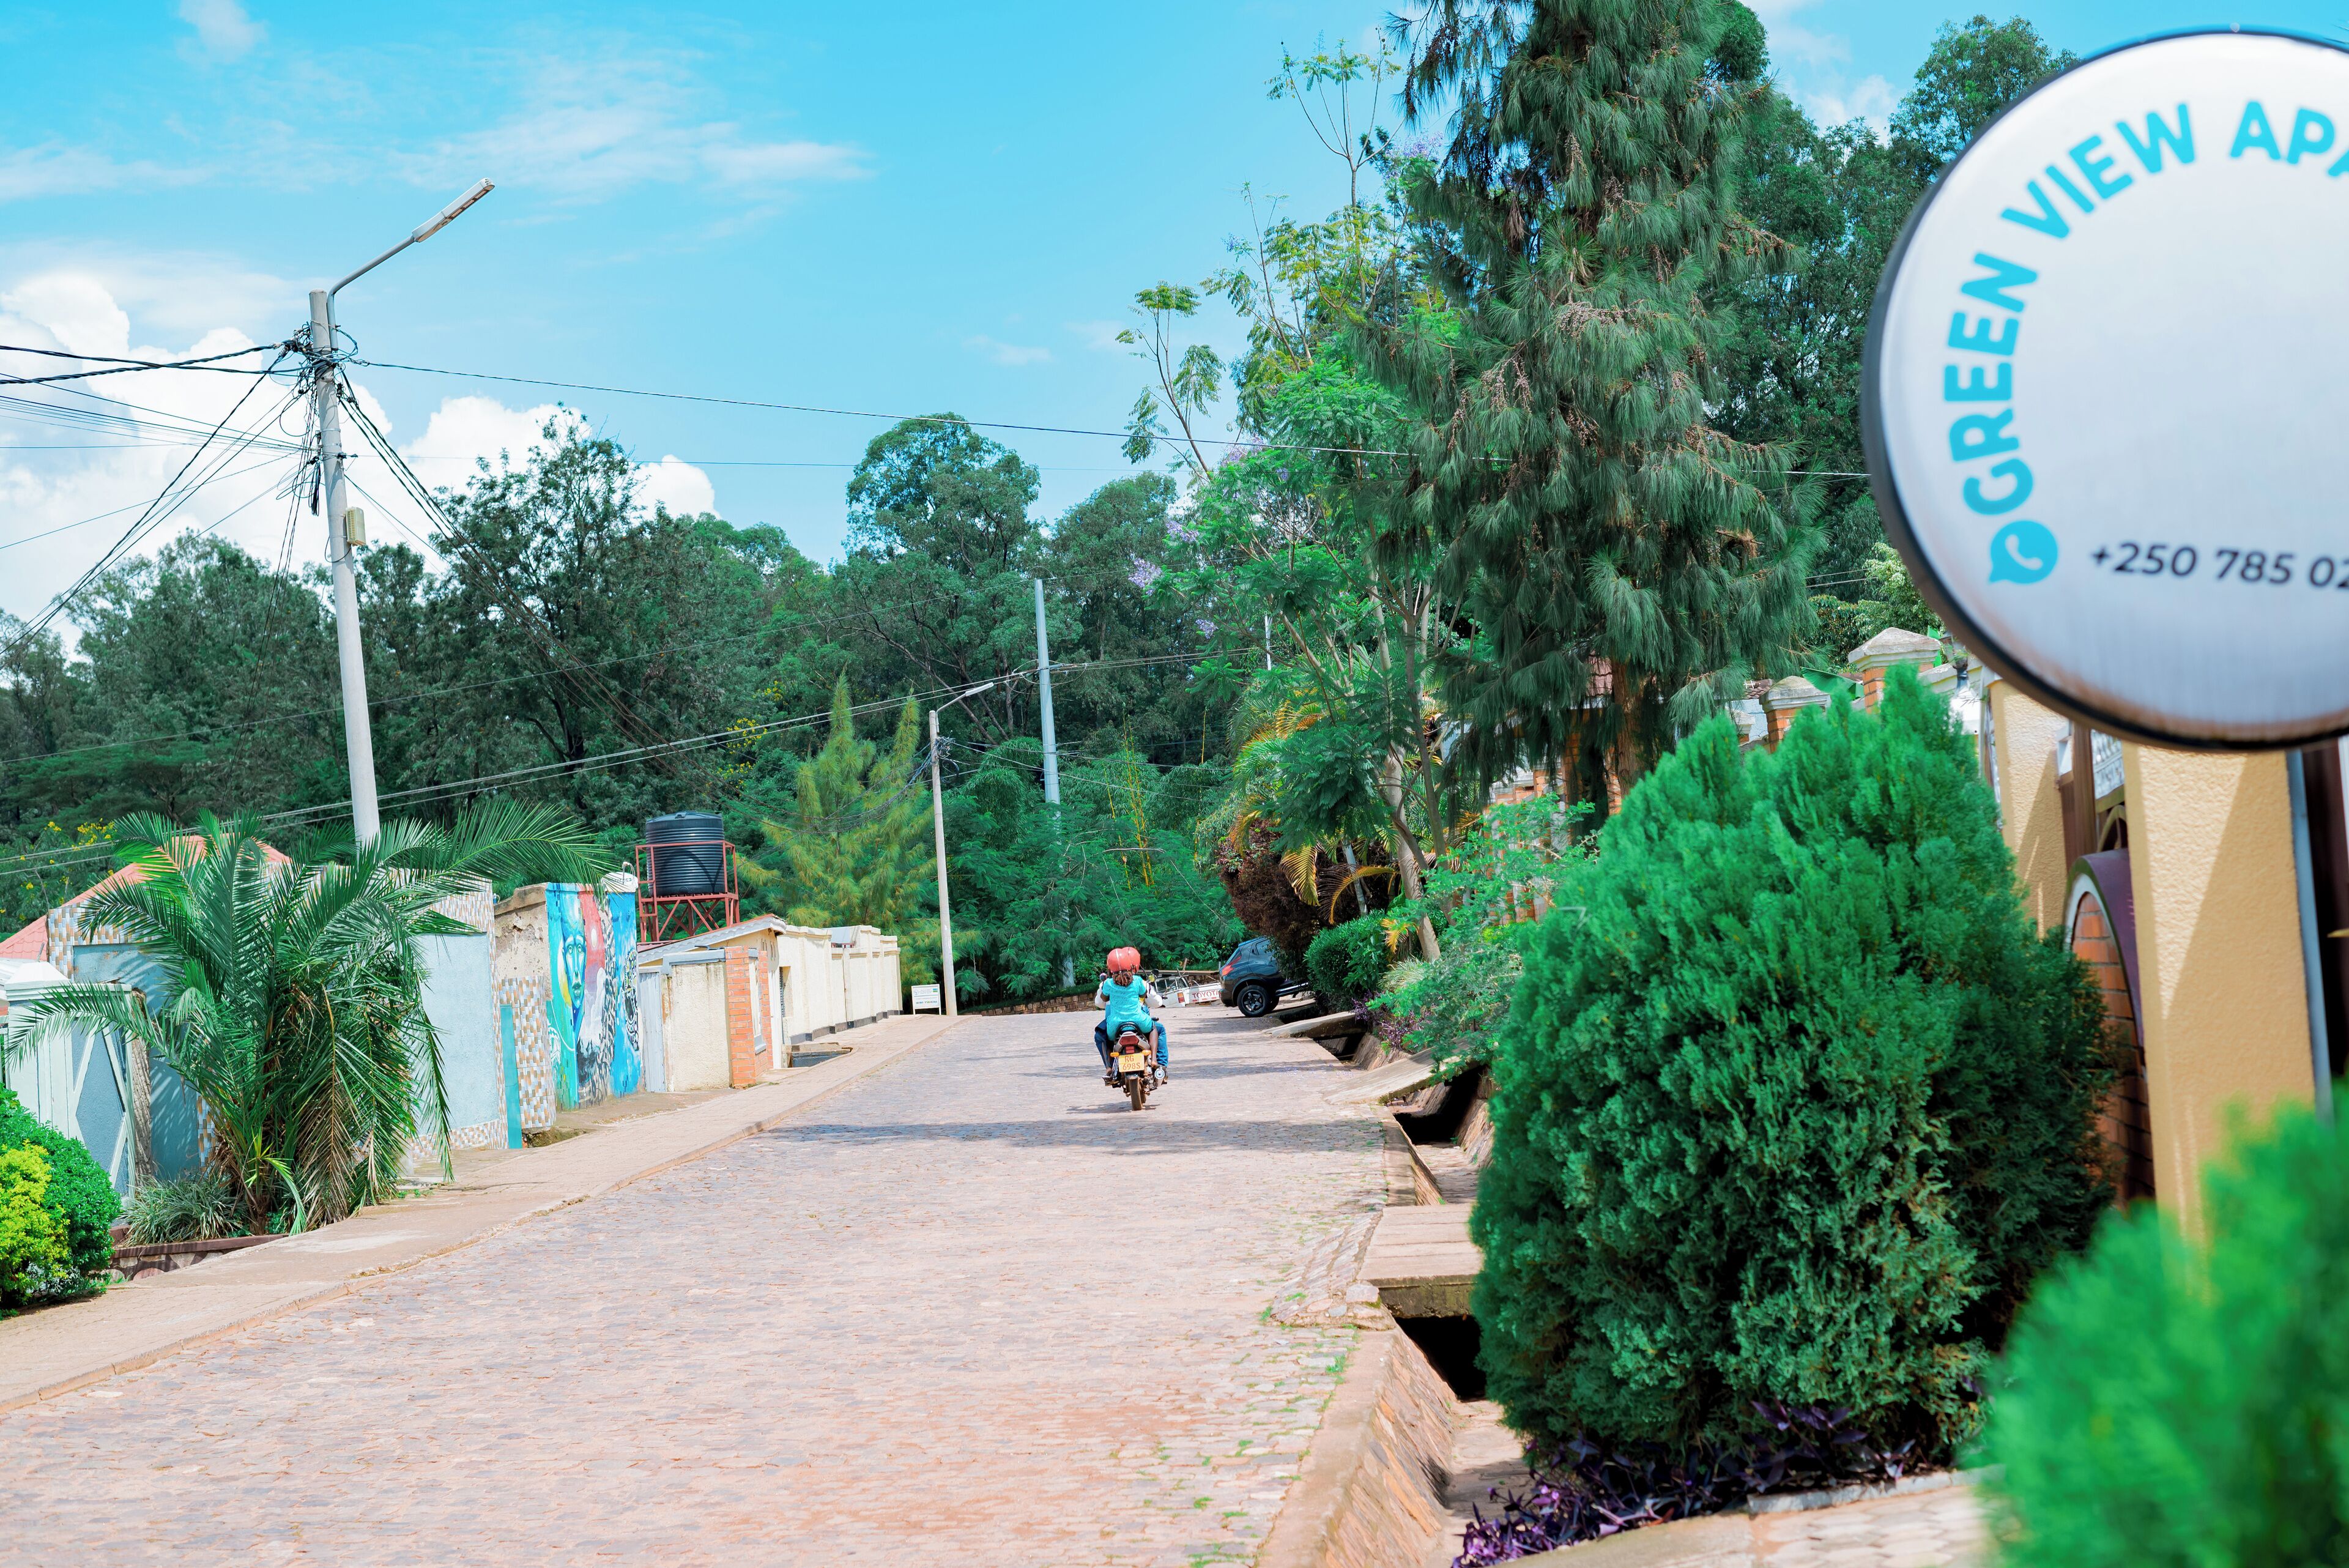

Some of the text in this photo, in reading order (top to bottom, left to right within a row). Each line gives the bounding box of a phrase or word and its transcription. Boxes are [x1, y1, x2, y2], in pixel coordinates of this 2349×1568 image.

[1942, 251, 2039, 516] GREEN
[2000, 102, 2196, 240] VIEW
[2092, 542, 2199, 578] +250
[2215, 549, 2295, 585] 785
